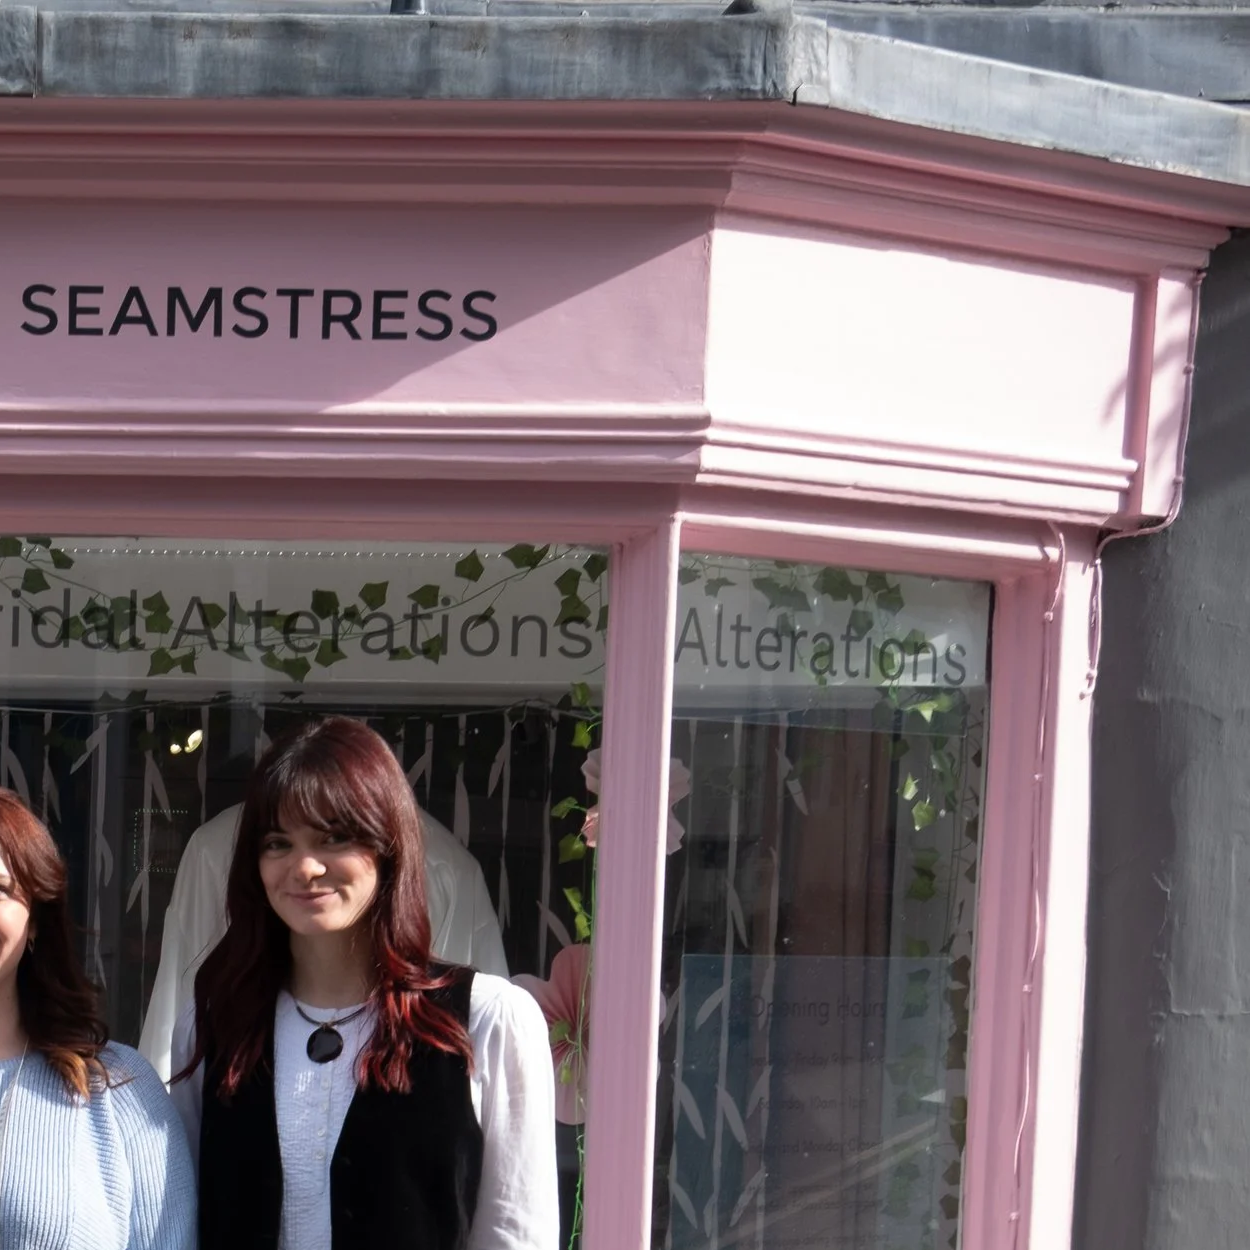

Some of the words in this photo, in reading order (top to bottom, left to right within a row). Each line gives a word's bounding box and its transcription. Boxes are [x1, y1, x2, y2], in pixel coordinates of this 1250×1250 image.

[20, 283, 498, 342] SEAMSTRESS
[169, 591, 594, 660] Alterations
[673, 602, 967, 686] Alterations
